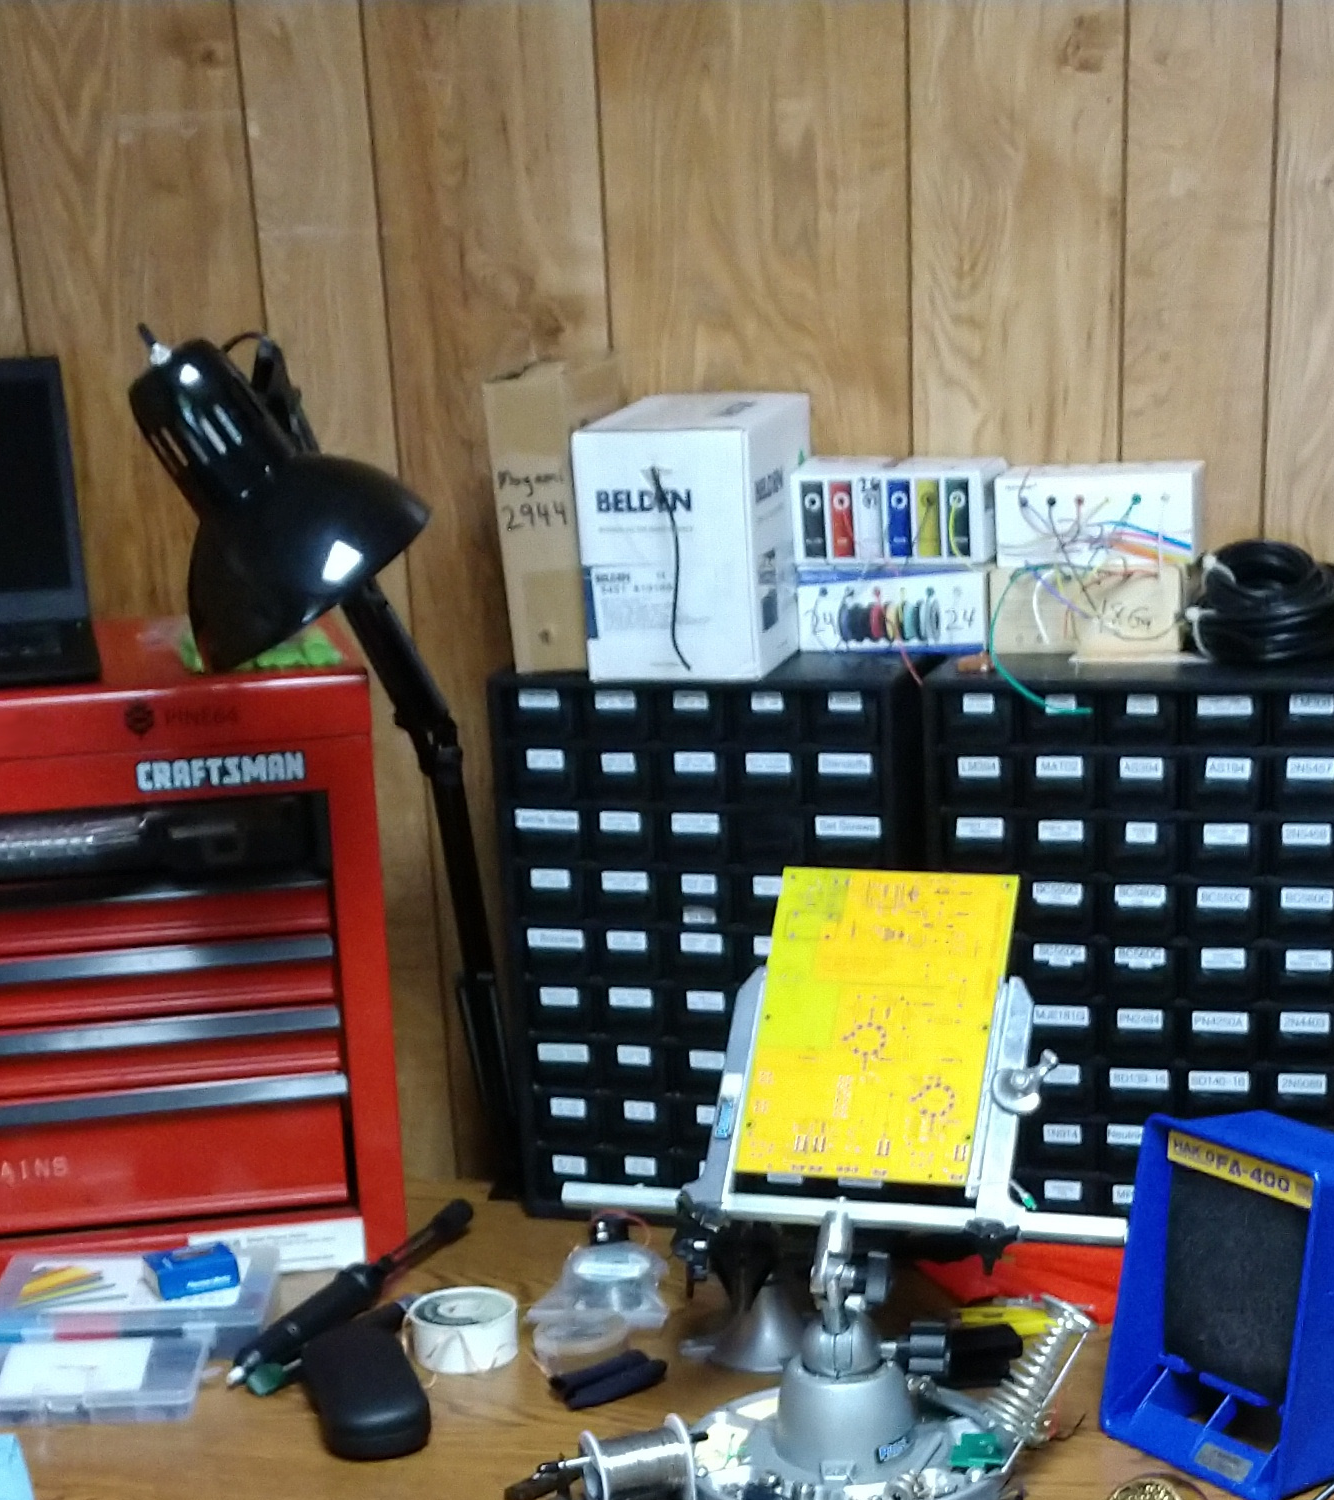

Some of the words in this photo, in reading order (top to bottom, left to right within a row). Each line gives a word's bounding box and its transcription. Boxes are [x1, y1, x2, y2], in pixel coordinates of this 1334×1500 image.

[501, 501, 569, 531] 2944
[945, 607, 975, 631] 24
[136, 750, 307, 793] CRAFTSMAN
[1215, 1154, 1290, 1194] FA-400
